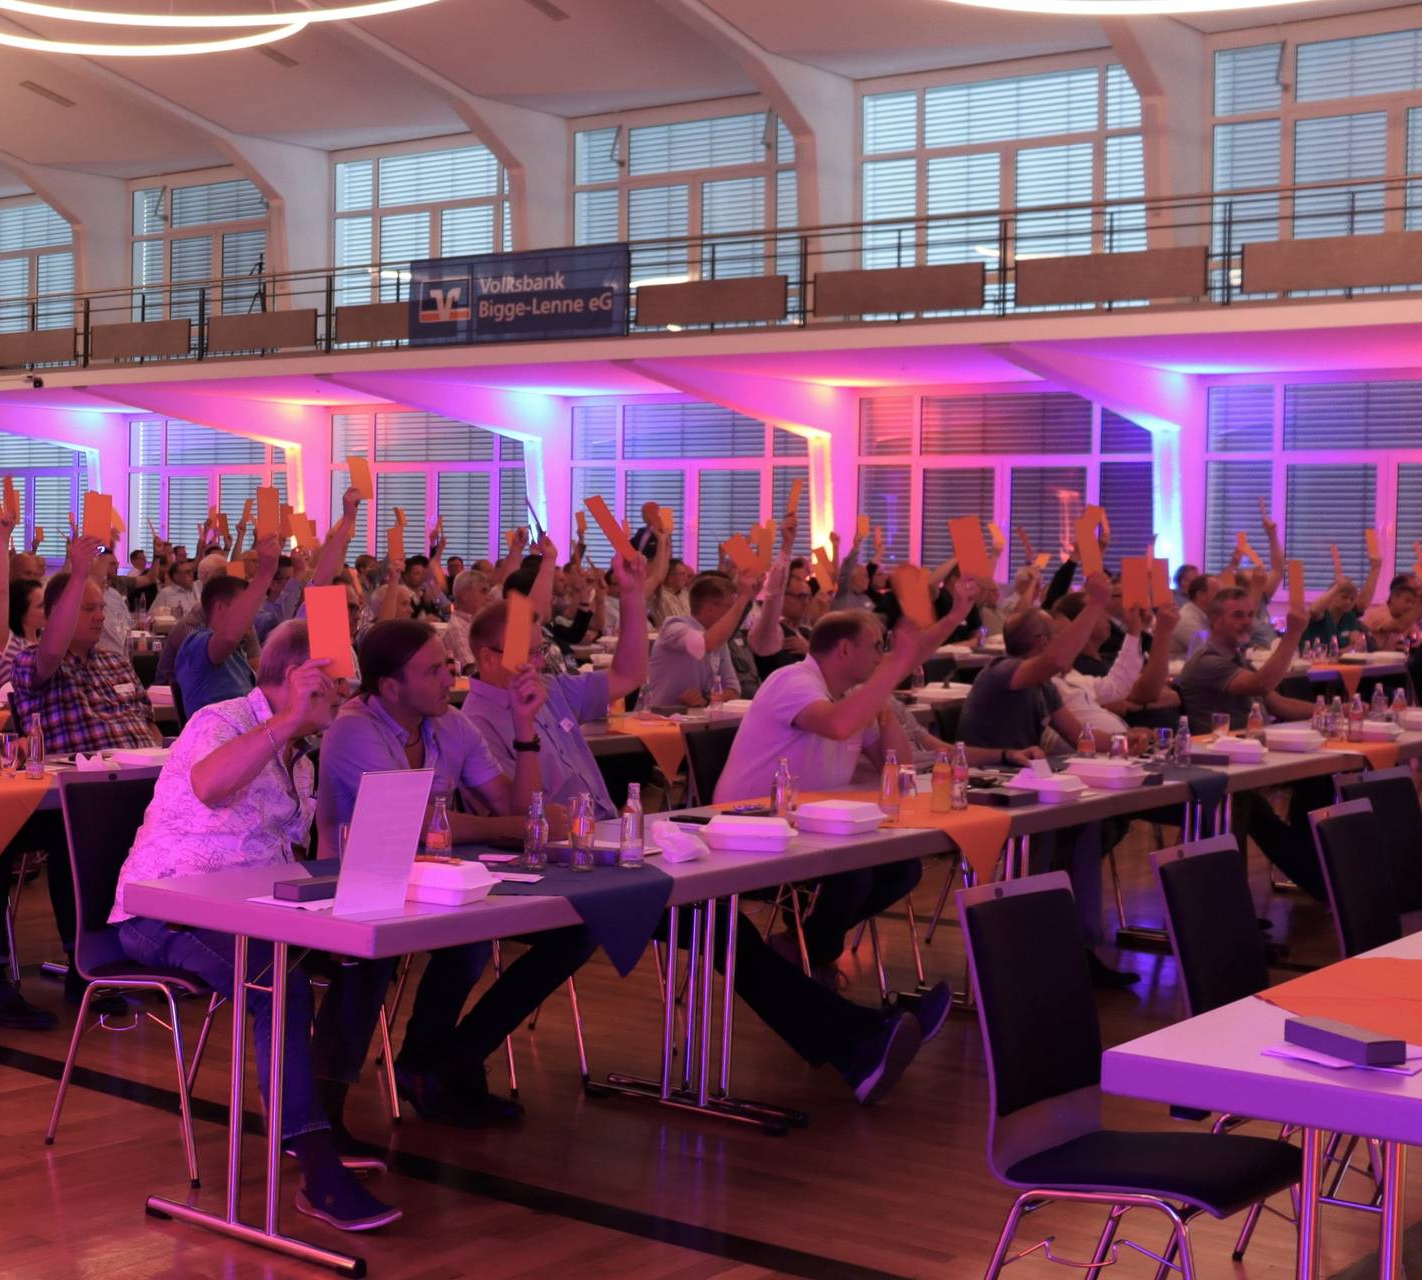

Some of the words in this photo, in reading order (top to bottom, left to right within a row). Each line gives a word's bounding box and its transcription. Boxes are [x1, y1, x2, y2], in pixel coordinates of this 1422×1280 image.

[479, 271, 565, 294] Volksbank
[478, 298, 584, 322] Bigge-Lenne
[589, 292, 613, 311] eG
